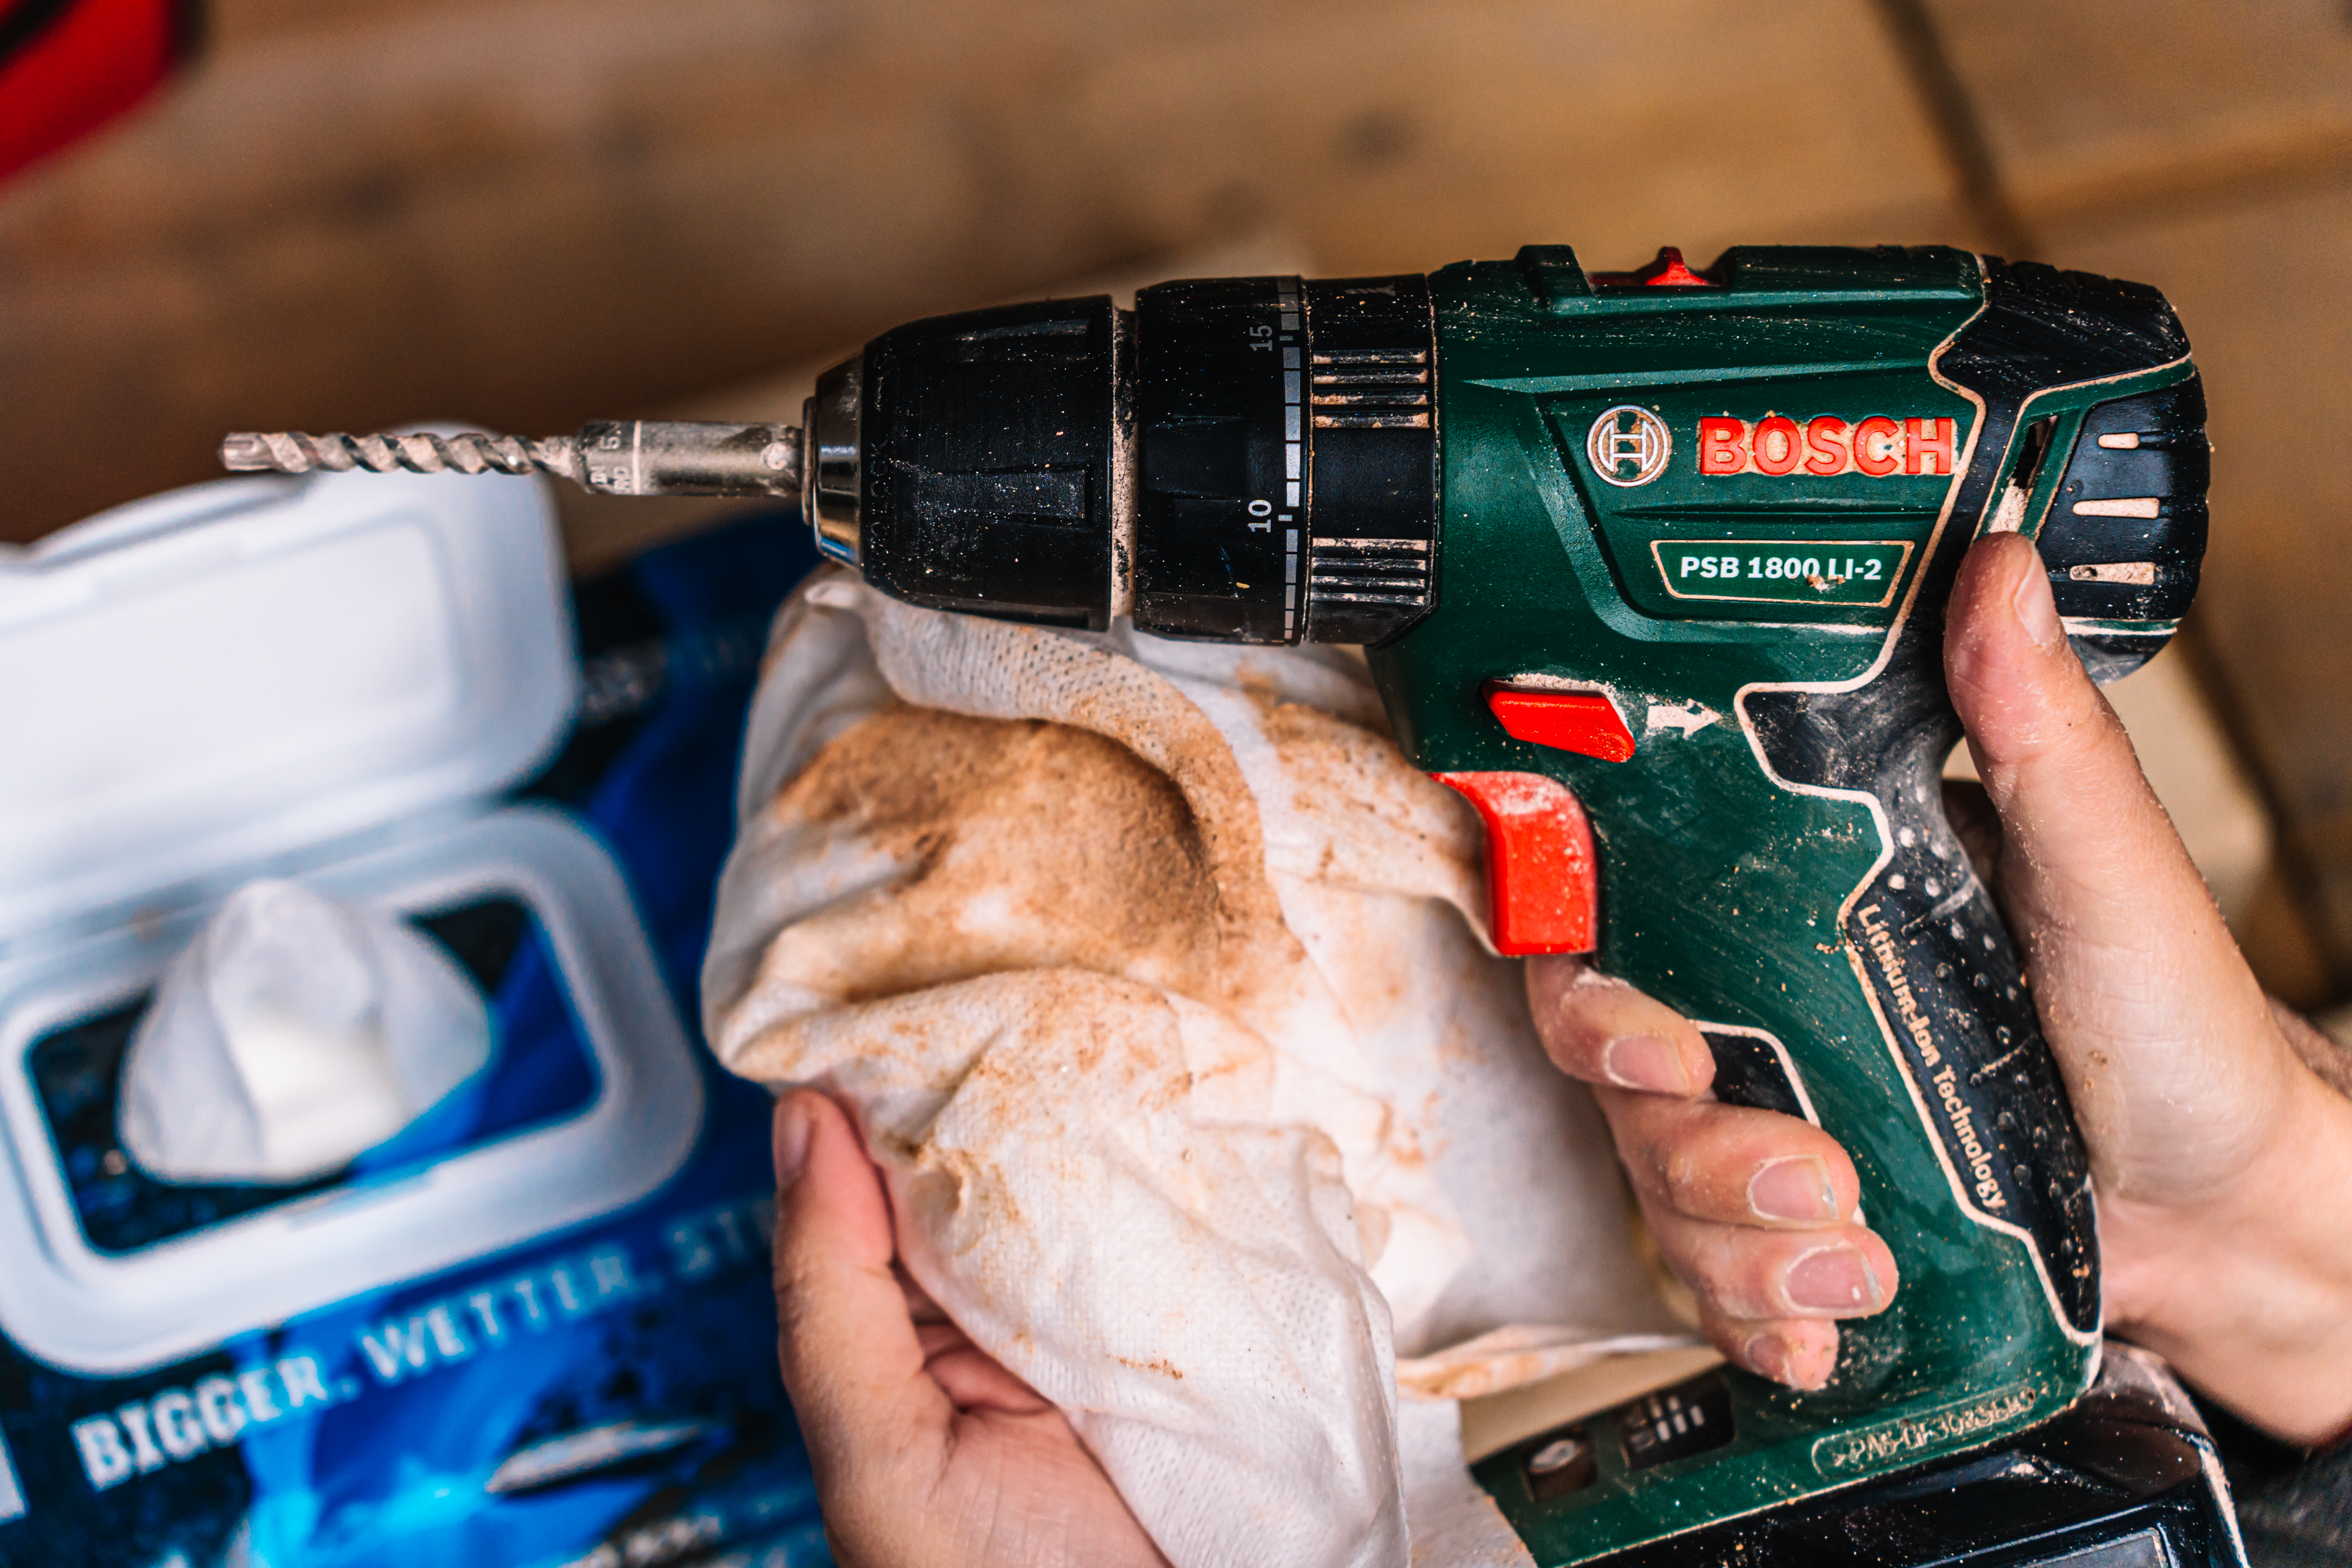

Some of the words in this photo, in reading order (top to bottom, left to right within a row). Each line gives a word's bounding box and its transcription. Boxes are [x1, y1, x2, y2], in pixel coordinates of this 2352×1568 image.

[1249, 325, 1273, 352] 15
[1699, 415, 1953, 475] BOSCH
[1247, 499, 1272, 533] 10
[1681, 557, 1740, 579] PSB
[1748, 557, 1820, 579] 1800
[1828, 558, 1882, 580] LI-2
[1857, 903, 1942, 1068] Lithium-Ion
[1932, 1063, 2006, 1209] Technology
[69, 1352, 360, 1492] BIGGER.
[359, 1247, 661, 1383] WETTER.
